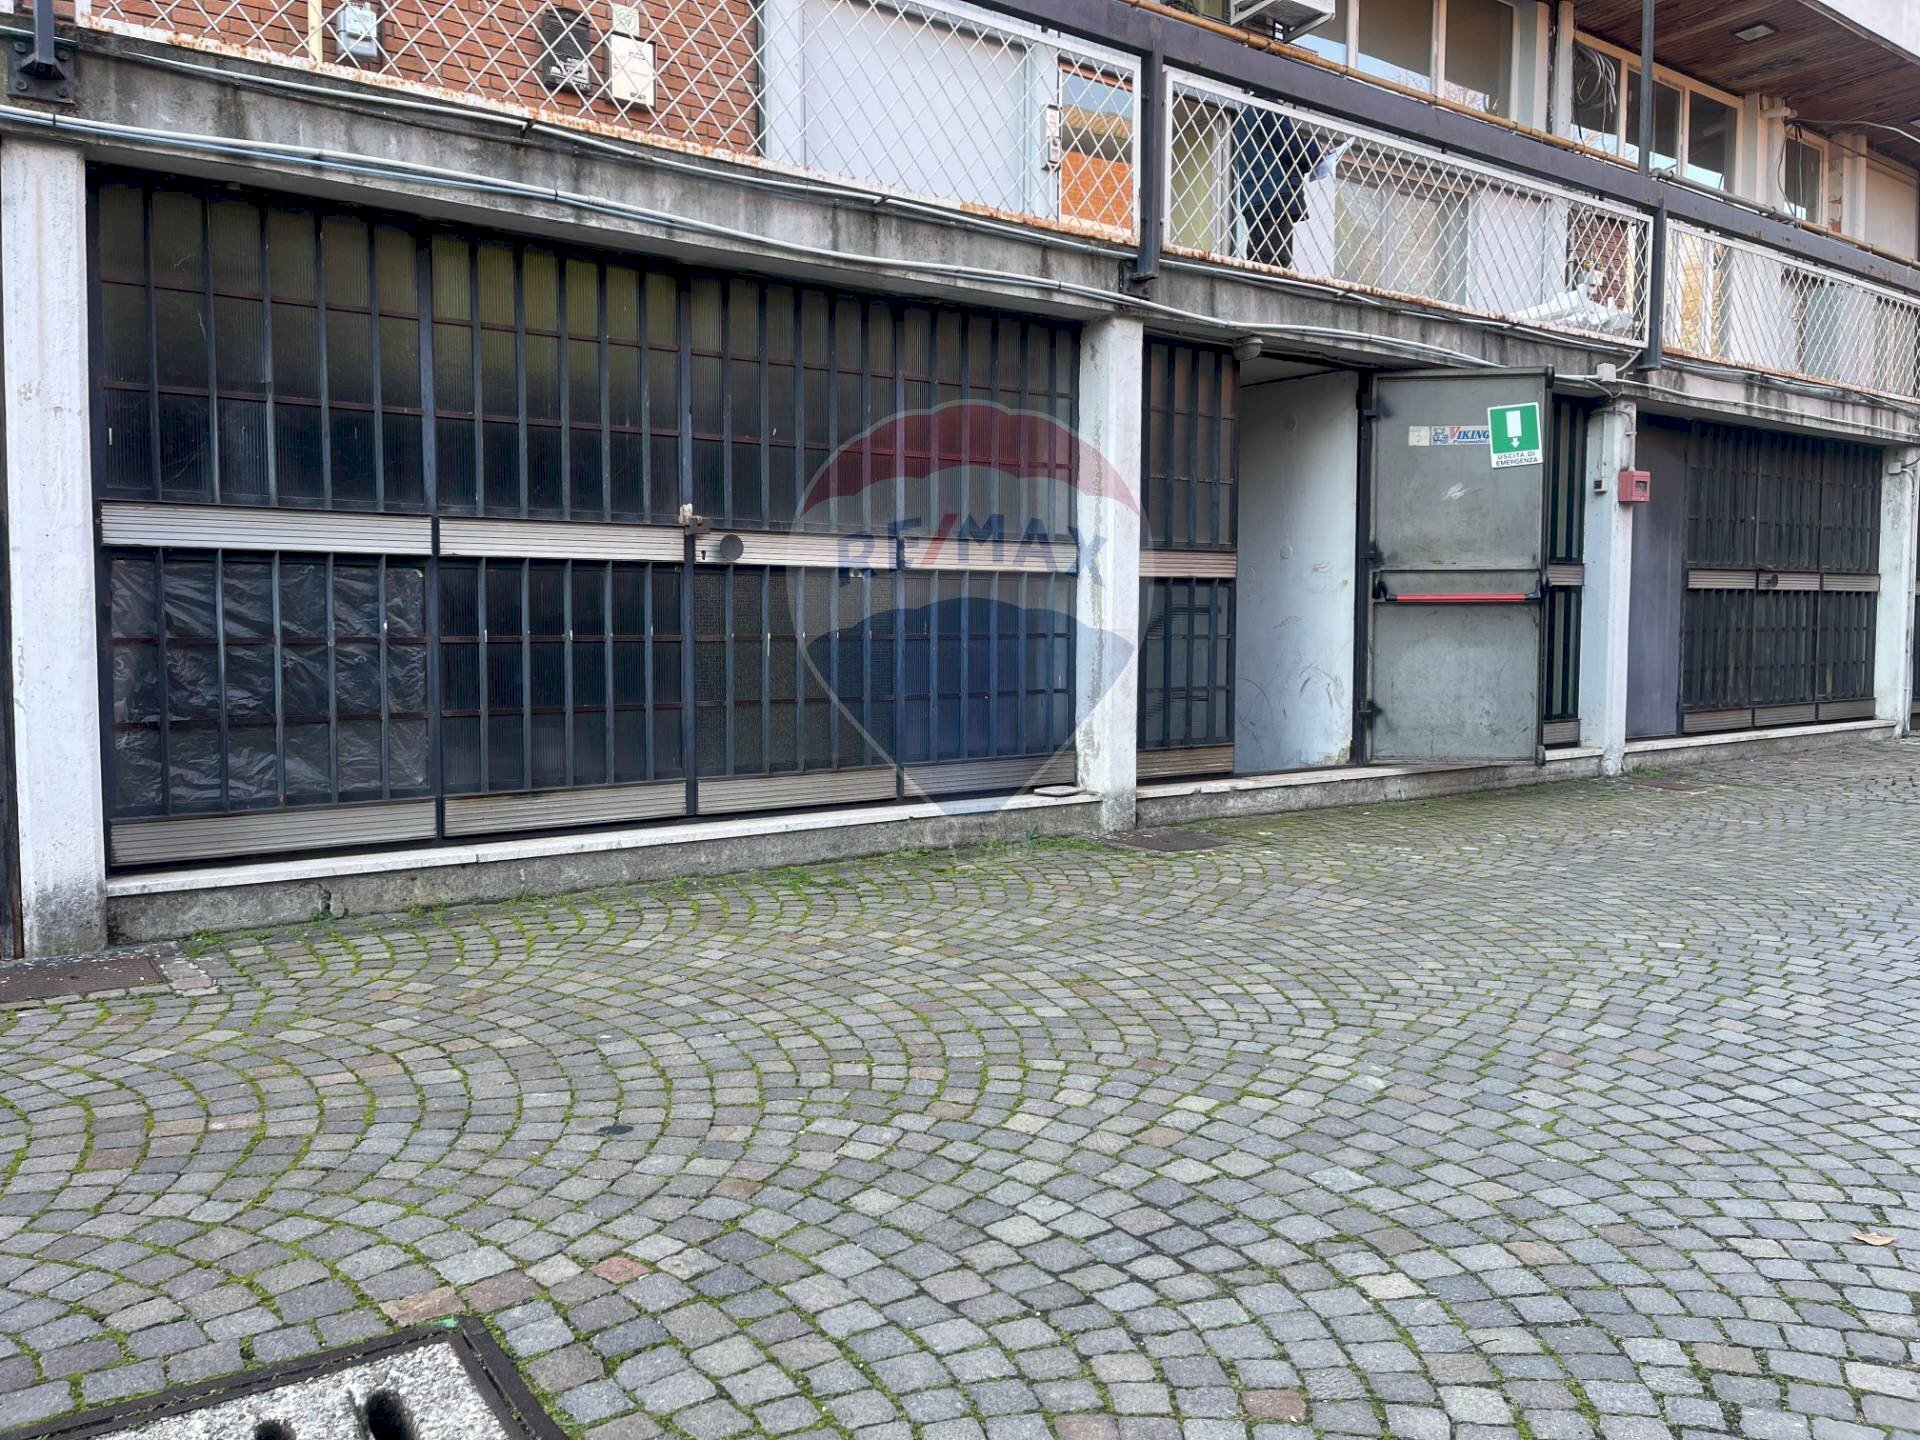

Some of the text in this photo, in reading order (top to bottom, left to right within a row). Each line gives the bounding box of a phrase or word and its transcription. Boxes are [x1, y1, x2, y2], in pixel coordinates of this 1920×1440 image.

[1450, 426, 1489, 440] VIKING
[1497, 451, 1524, 460] USCITA
[1496, 457, 1538, 466] EMERGENZA
